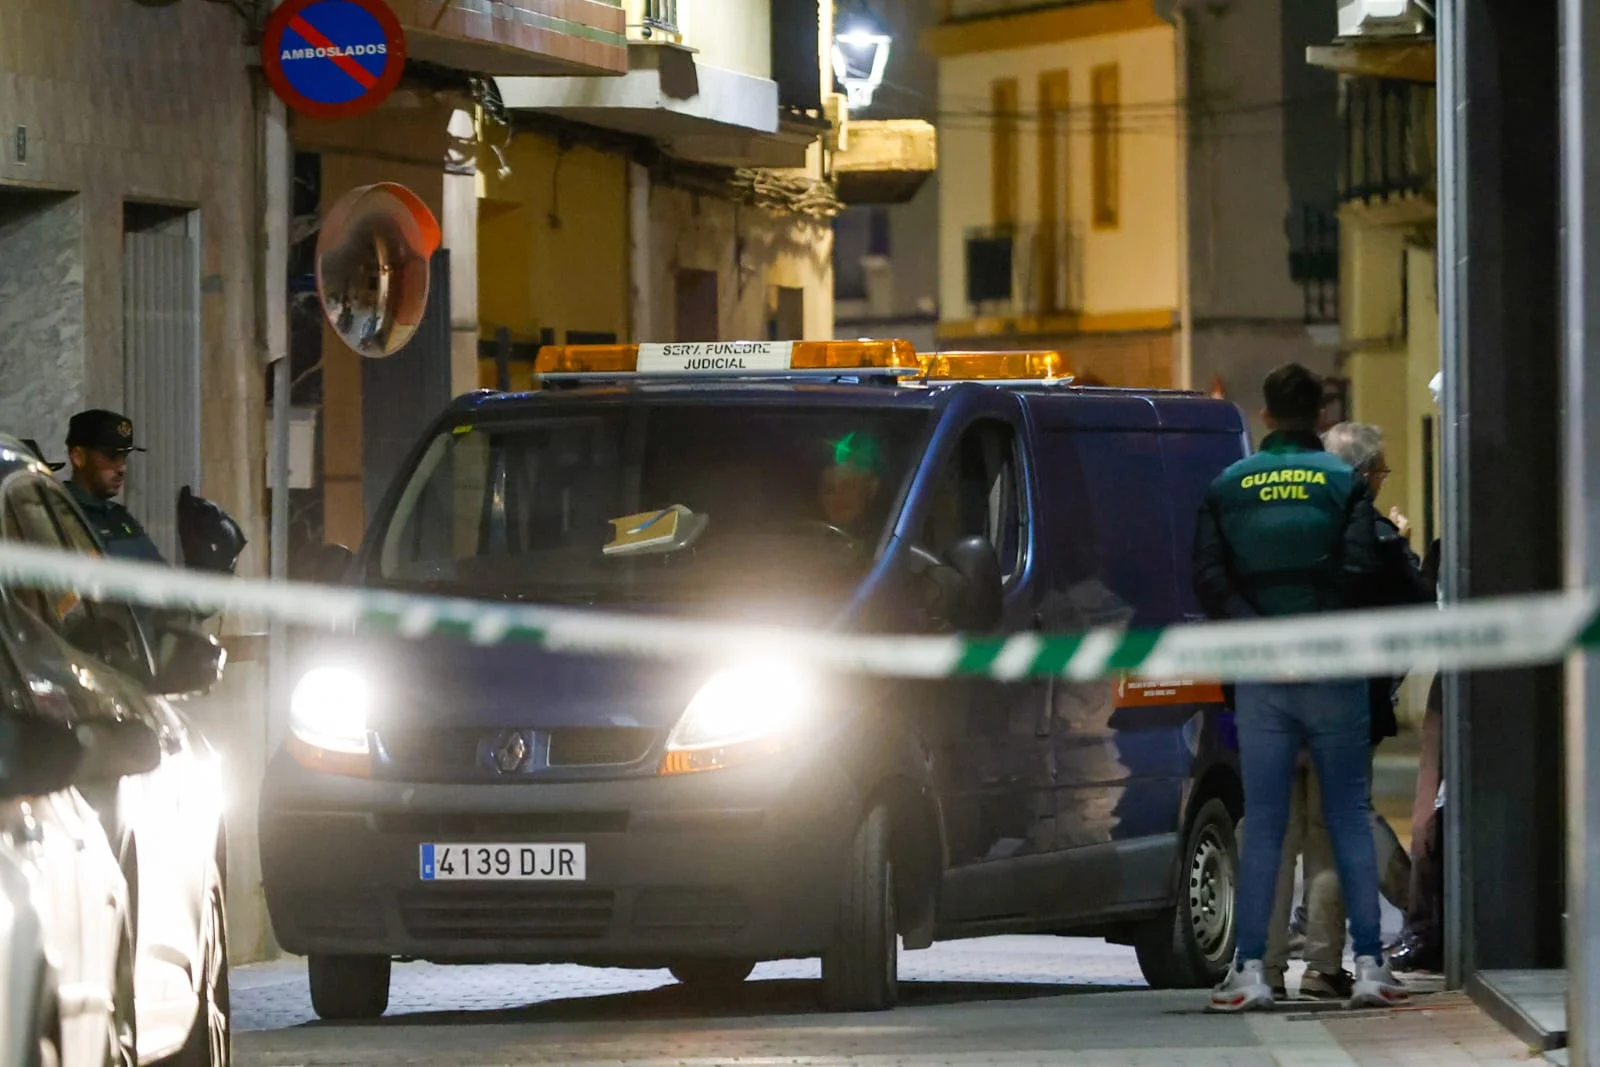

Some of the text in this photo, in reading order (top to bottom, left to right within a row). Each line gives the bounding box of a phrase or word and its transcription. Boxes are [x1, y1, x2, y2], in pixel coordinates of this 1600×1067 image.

[662, 344, 700, 356] SERV.
[684, 358, 746, 370] JUDICIAL
[1241, 469, 1326, 488] GUARDIA
[1260, 486, 1309, 501] CIVIL
[440, 848, 511, 876] 4139
[520, 848, 574, 876] DJR
